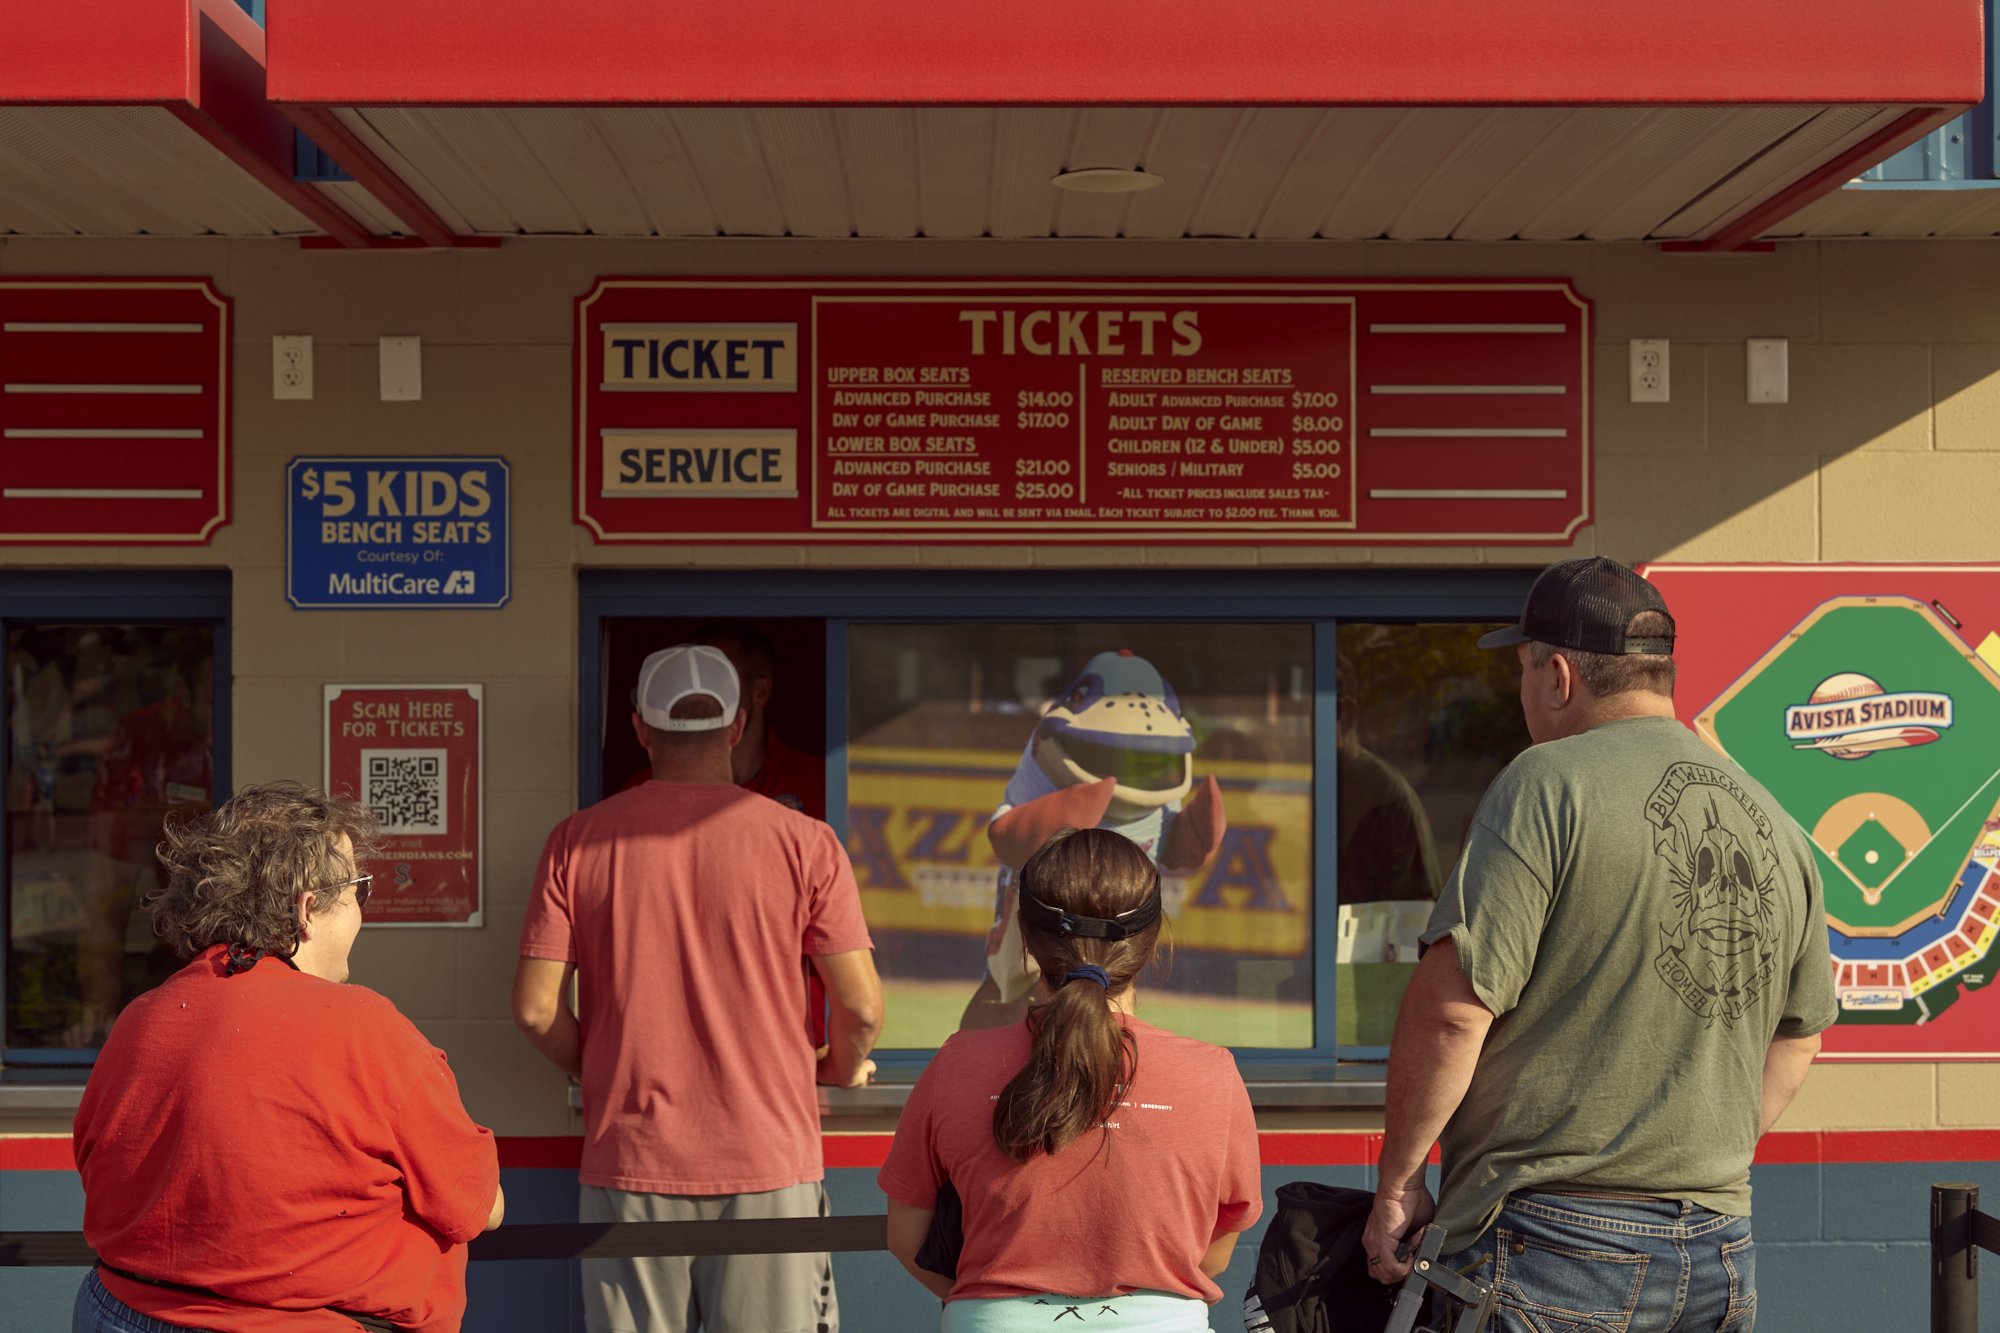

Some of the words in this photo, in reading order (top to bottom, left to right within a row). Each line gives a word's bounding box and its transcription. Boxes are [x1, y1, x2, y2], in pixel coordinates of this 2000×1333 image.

[959, 311, 1202, 356] TICKETS
[612, 340, 784, 379] TICKET
[828, 368, 877, 383] UPPER
[883, 368, 915, 383] BOX
[920, 368, 970, 383] SEATS
[1102, 369, 1182, 384] RESERVED
[1186, 369, 1238, 384] BENCH
[1242, 369, 1292, 384] SEATS
[1018, 390, 1073, 408] $14.00
[1293, 391, 1338, 408] $7.00
[1018, 411, 1069, 429] $17.00
[1293, 415, 1343, 433] $8.00
[828, 437, 884, 452] LOWER
[889, 437, 921, 452] BOX
[924, 437, 975, 452] SEATS
[1293, 438, 1340, 456] $5.00
[620, 448, 782, 483] SERVICE
[1016, 459, 1070, 476] $21.00
[1293, 462, 1340, 479] $5.00
[302, 468, 355, 517] $5
[367, 471, 491, 517] KIDS
[1016, 482, 1073, 500] $25.00
[322, 522, 401, 543] BENCH
[413, 522, 491, 543] SEATS
[357, 550, 419, 564] Courtesy
[423, 550, 443, 562] Of:
[329, 573, 439, 594] MultiCare
[353, 701, 399, 718] SCAN
[409, 702, 453, 718] HERE
[1791, 708, 1856, 731] AVISTA
[1860, 700, 1945, 723] STADIUM
[343, 722, 376, 737] FOR
[386, 720, 464, 737] TICKETS
[1651, 766, 1767, 828] BUTTWHACKERS
[1662, 957, 1707, 1012] HOMER
[1734, 965, 1772, 1015] ALAKA
[1140, 1103, 1173, 1111] GENEROSITY
